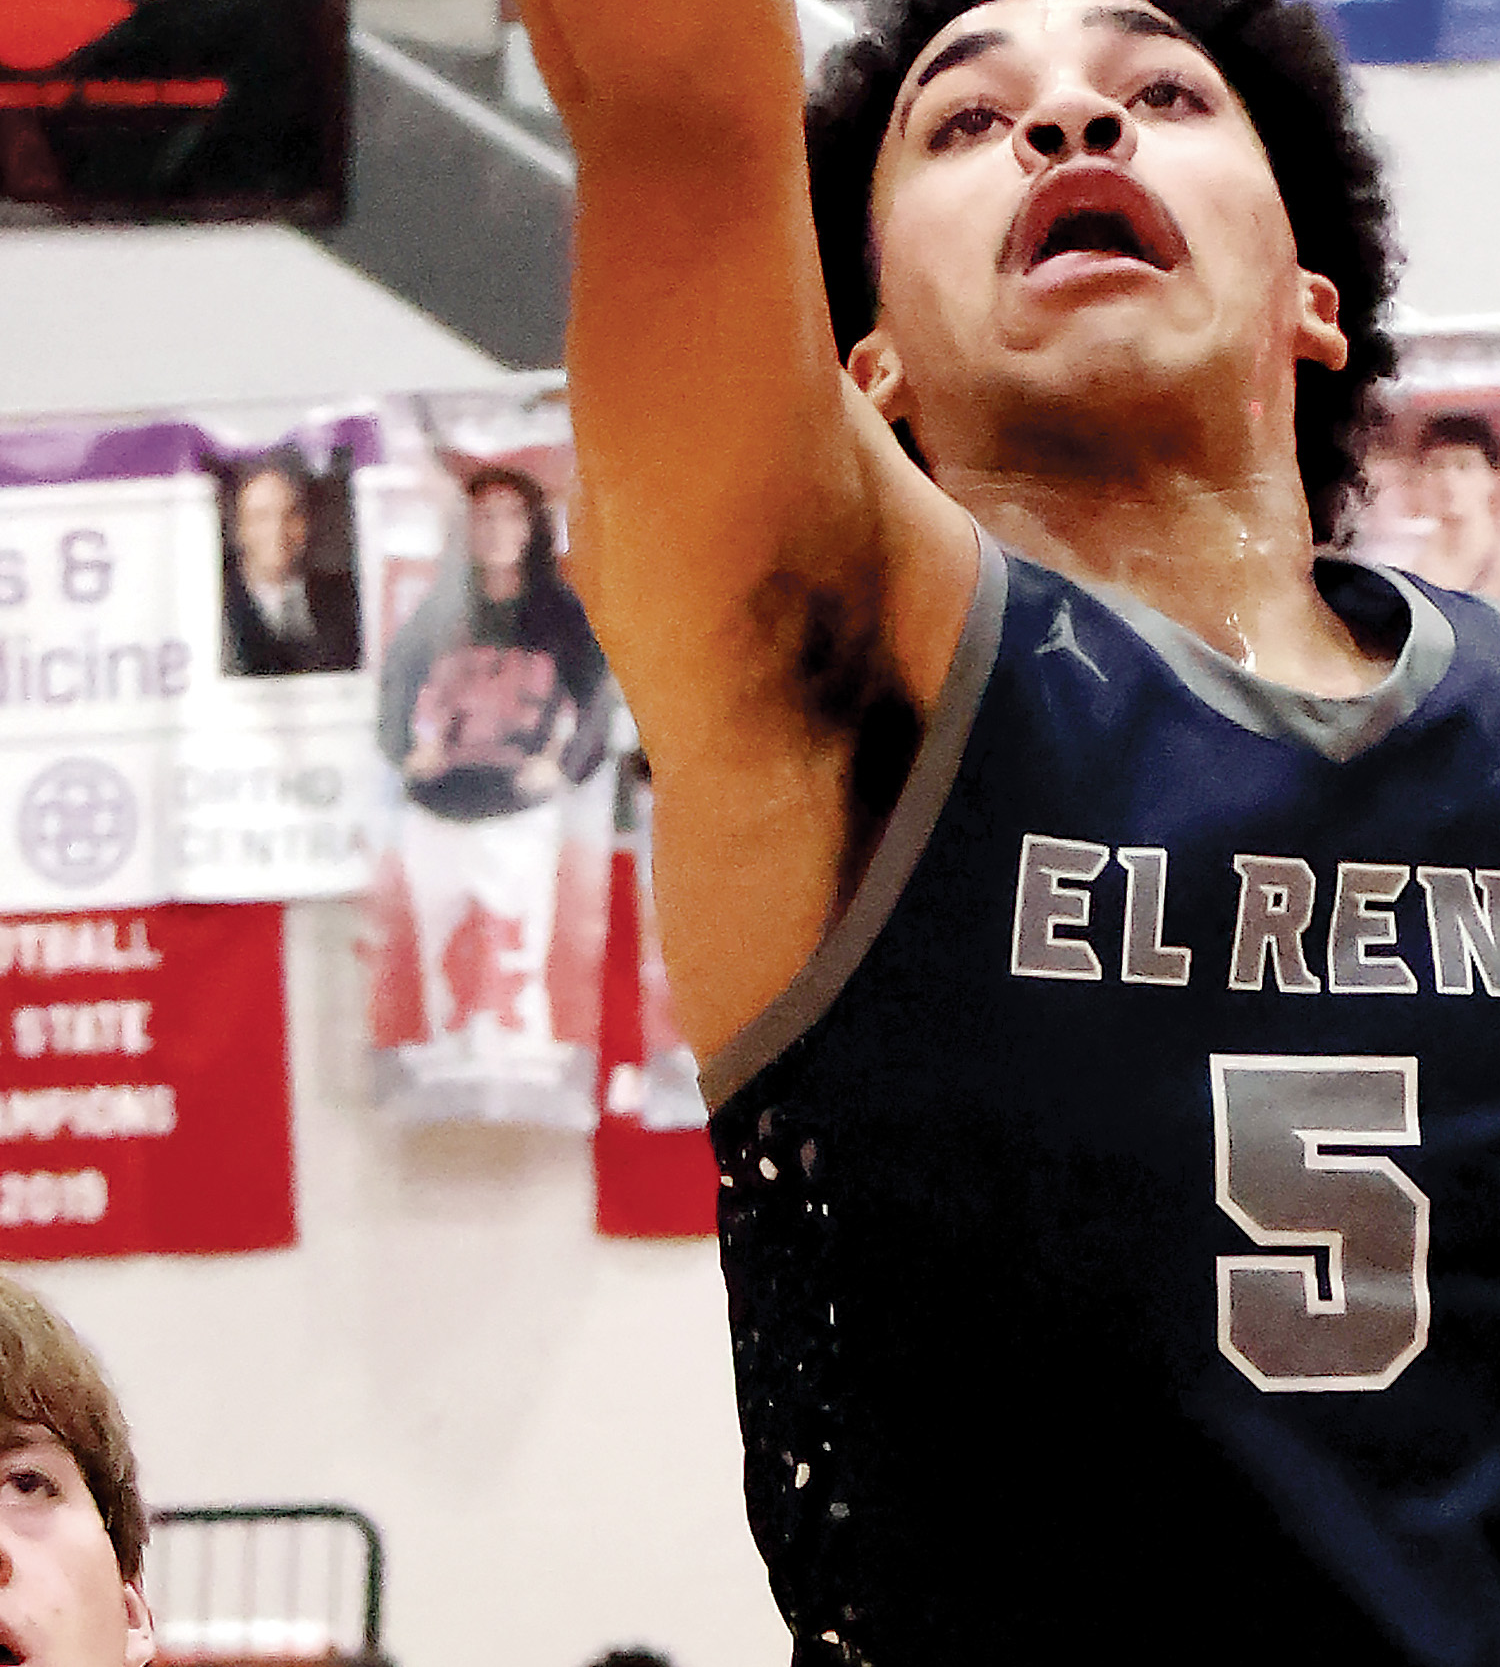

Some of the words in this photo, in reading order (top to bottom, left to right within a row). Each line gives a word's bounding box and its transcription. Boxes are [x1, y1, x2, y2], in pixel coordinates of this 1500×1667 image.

[0, 631, 192, 705] icine
[1010, 833, 1193, 987] EL
[1209, 1053, 1431, 1393] 5
